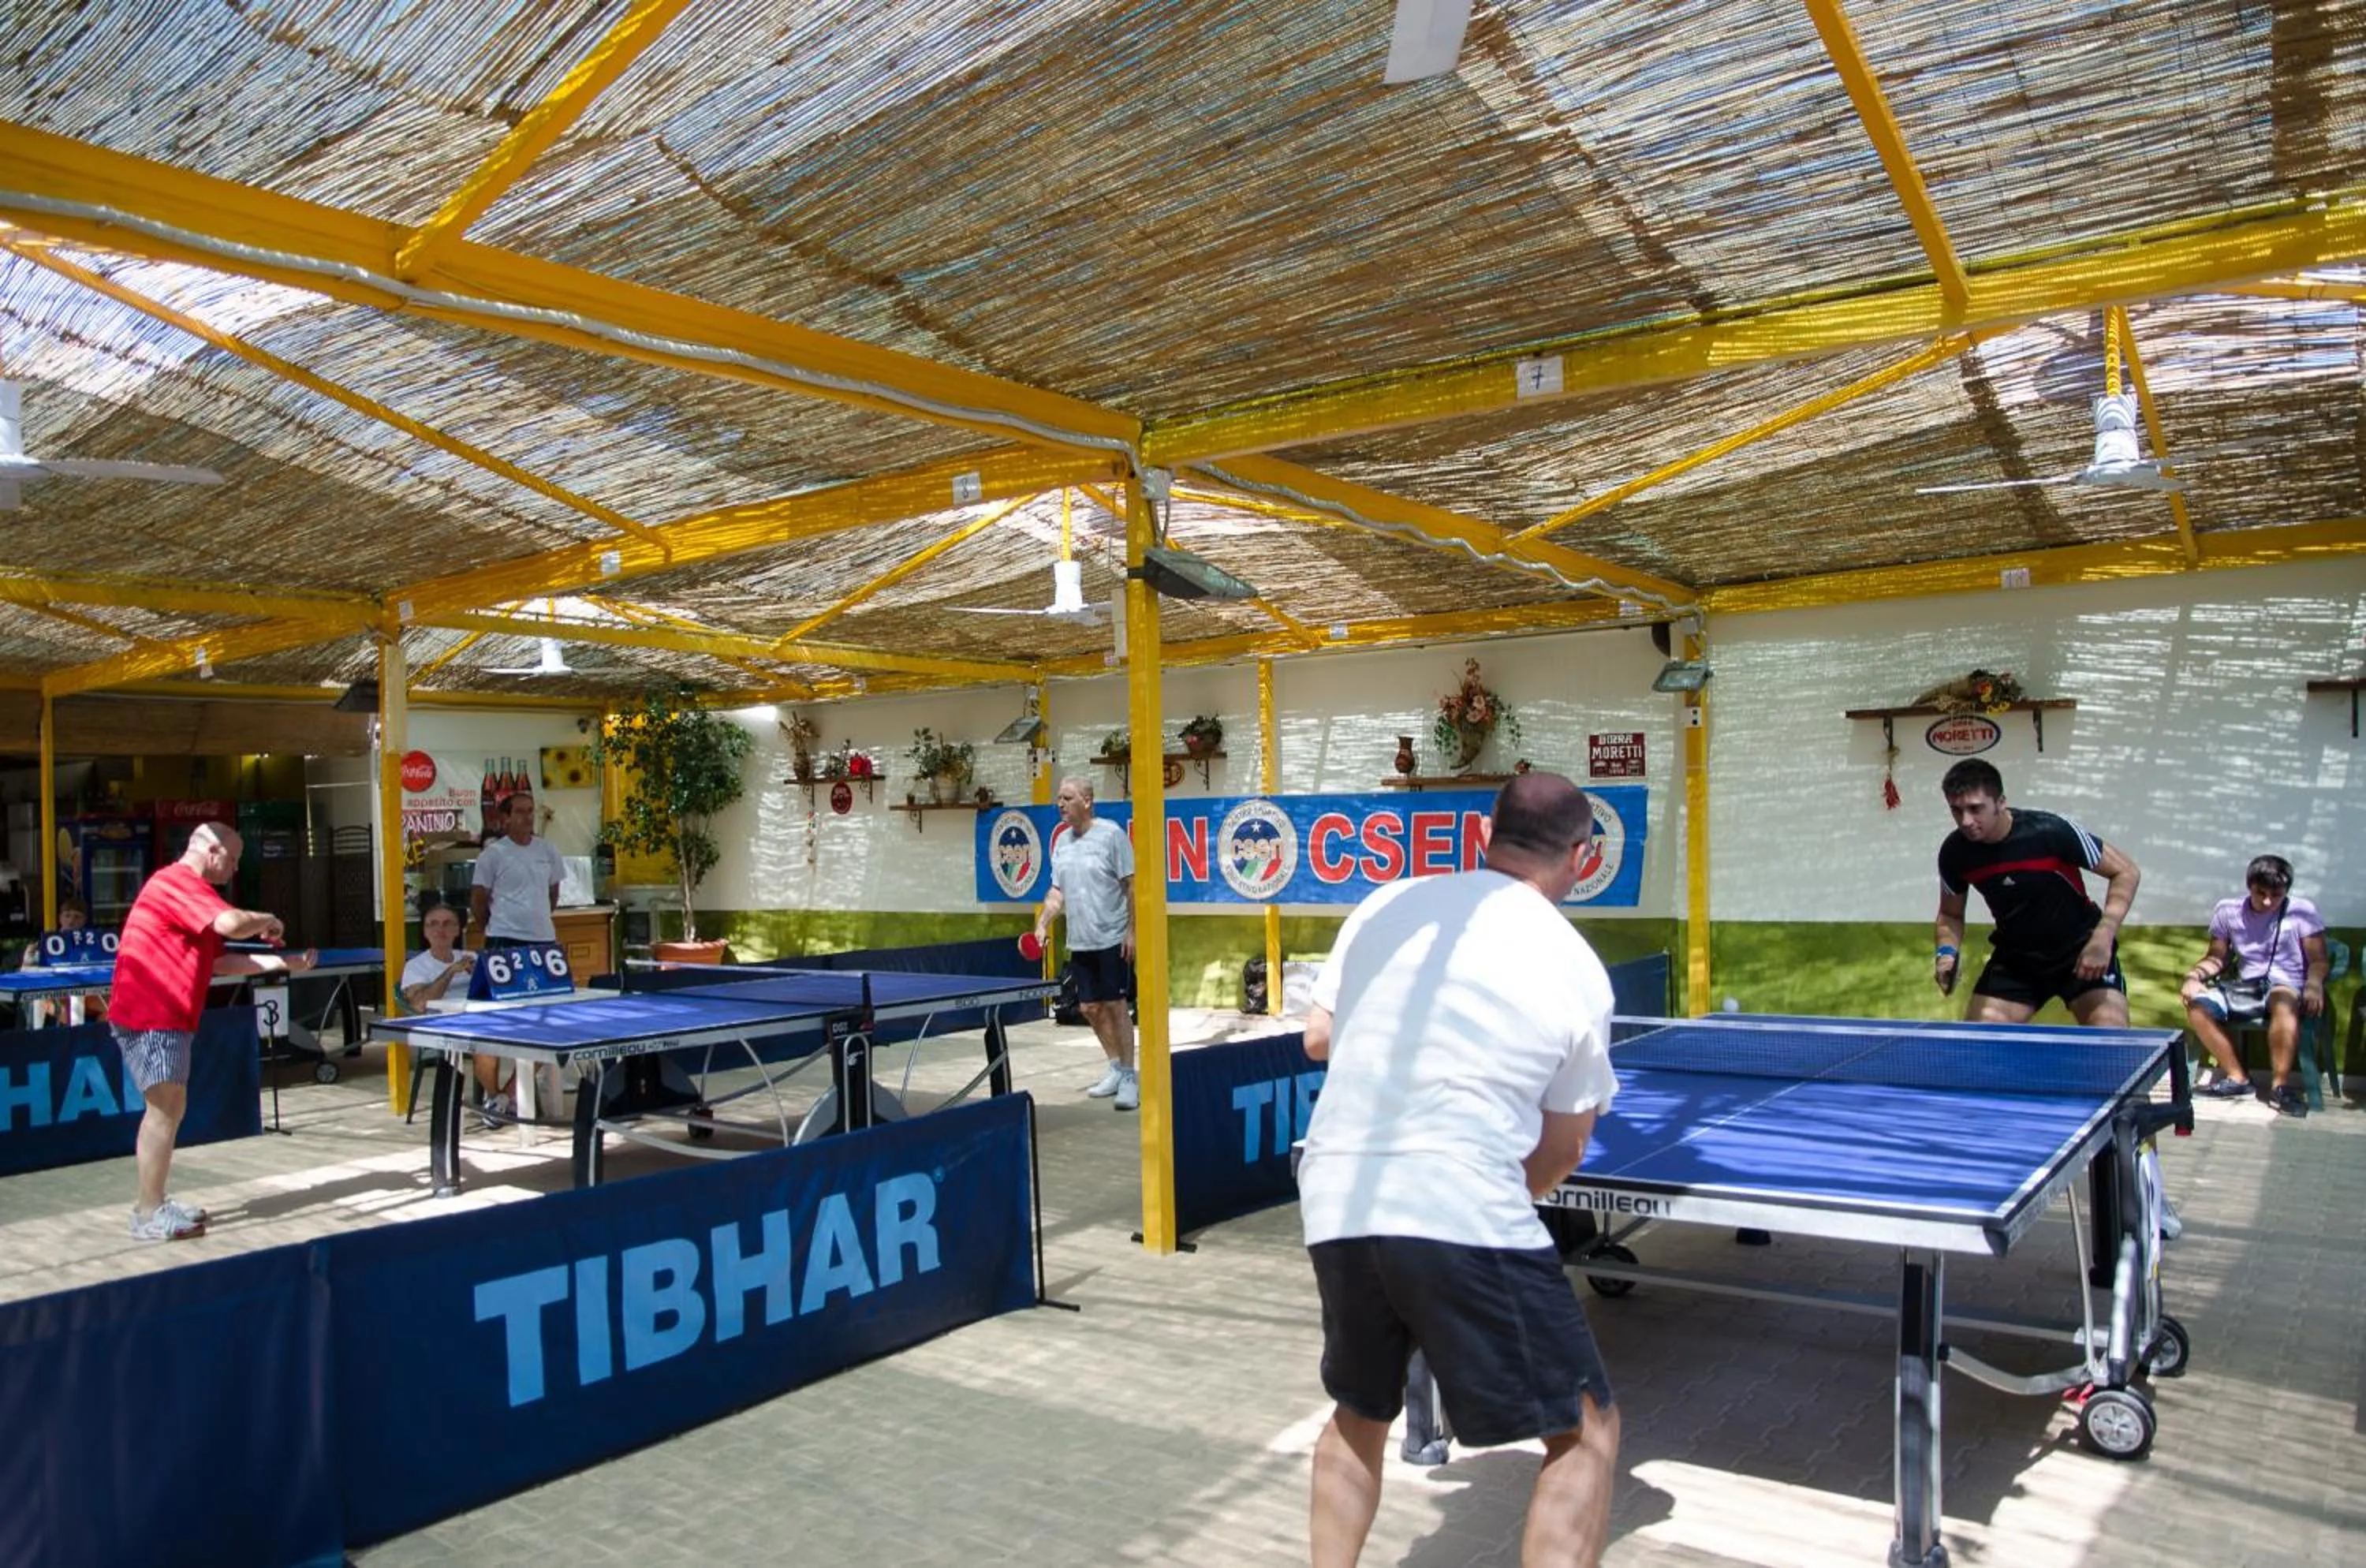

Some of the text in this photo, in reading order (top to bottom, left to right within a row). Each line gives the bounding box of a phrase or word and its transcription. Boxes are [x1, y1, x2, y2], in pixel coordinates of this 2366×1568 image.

[1592, 745, 1642, 760] MORETTI
[488, 950, 567, 984] 6 2 0 6
[473, 1171, 942, 1407] TIBHAR
